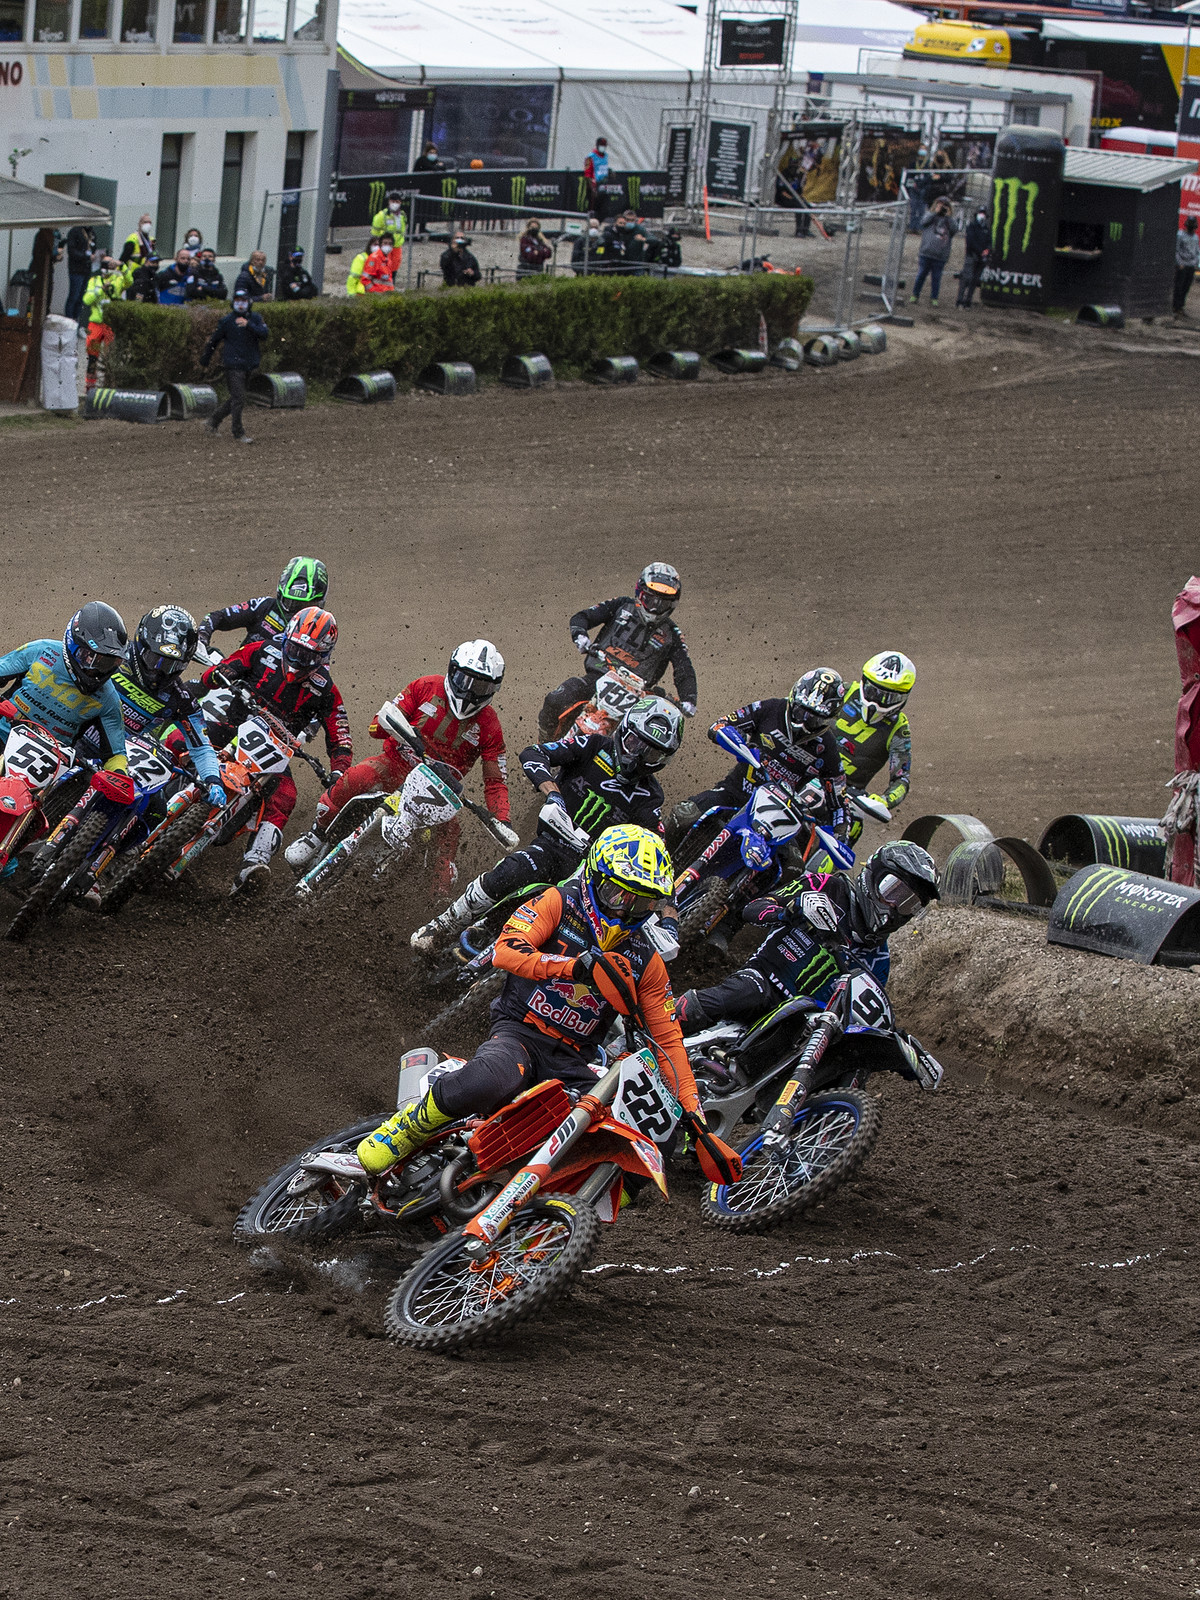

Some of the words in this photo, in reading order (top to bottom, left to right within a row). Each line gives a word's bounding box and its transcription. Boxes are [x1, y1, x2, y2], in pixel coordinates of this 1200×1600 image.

[604, 646, 640, 669] KTM
[19, 687, 46, 711] Honda
[26, 661, 103, 716] SHOT
[110, 672, 166, 713] MOOSE
[598, 680, 640, 712] 152
[122, 704, 150, 727] EBBEN
[238, 732, 285, 771] 911
[769, 728, 818, 763] MOOSE
[7, 742, 58, 784] 53
[126, 747, 167, 784] 32
[107, 774, 131, 790] UFO
[1121, 822, 1160, 838] MONST
[1113, 880, 1189, 910] MONSTER
[1113, 895, 1165, 914] ENERGY
[502, 937, 536, 957] KTM
[611, 954, 631, 978] KTM
[635, 1055, 654, 1078] MXGP
[621, 1069, 673, 1142] 222
[730, 1157, 743, 1178] KTM
[483, 1181, 521, 1221] MOTOREX
